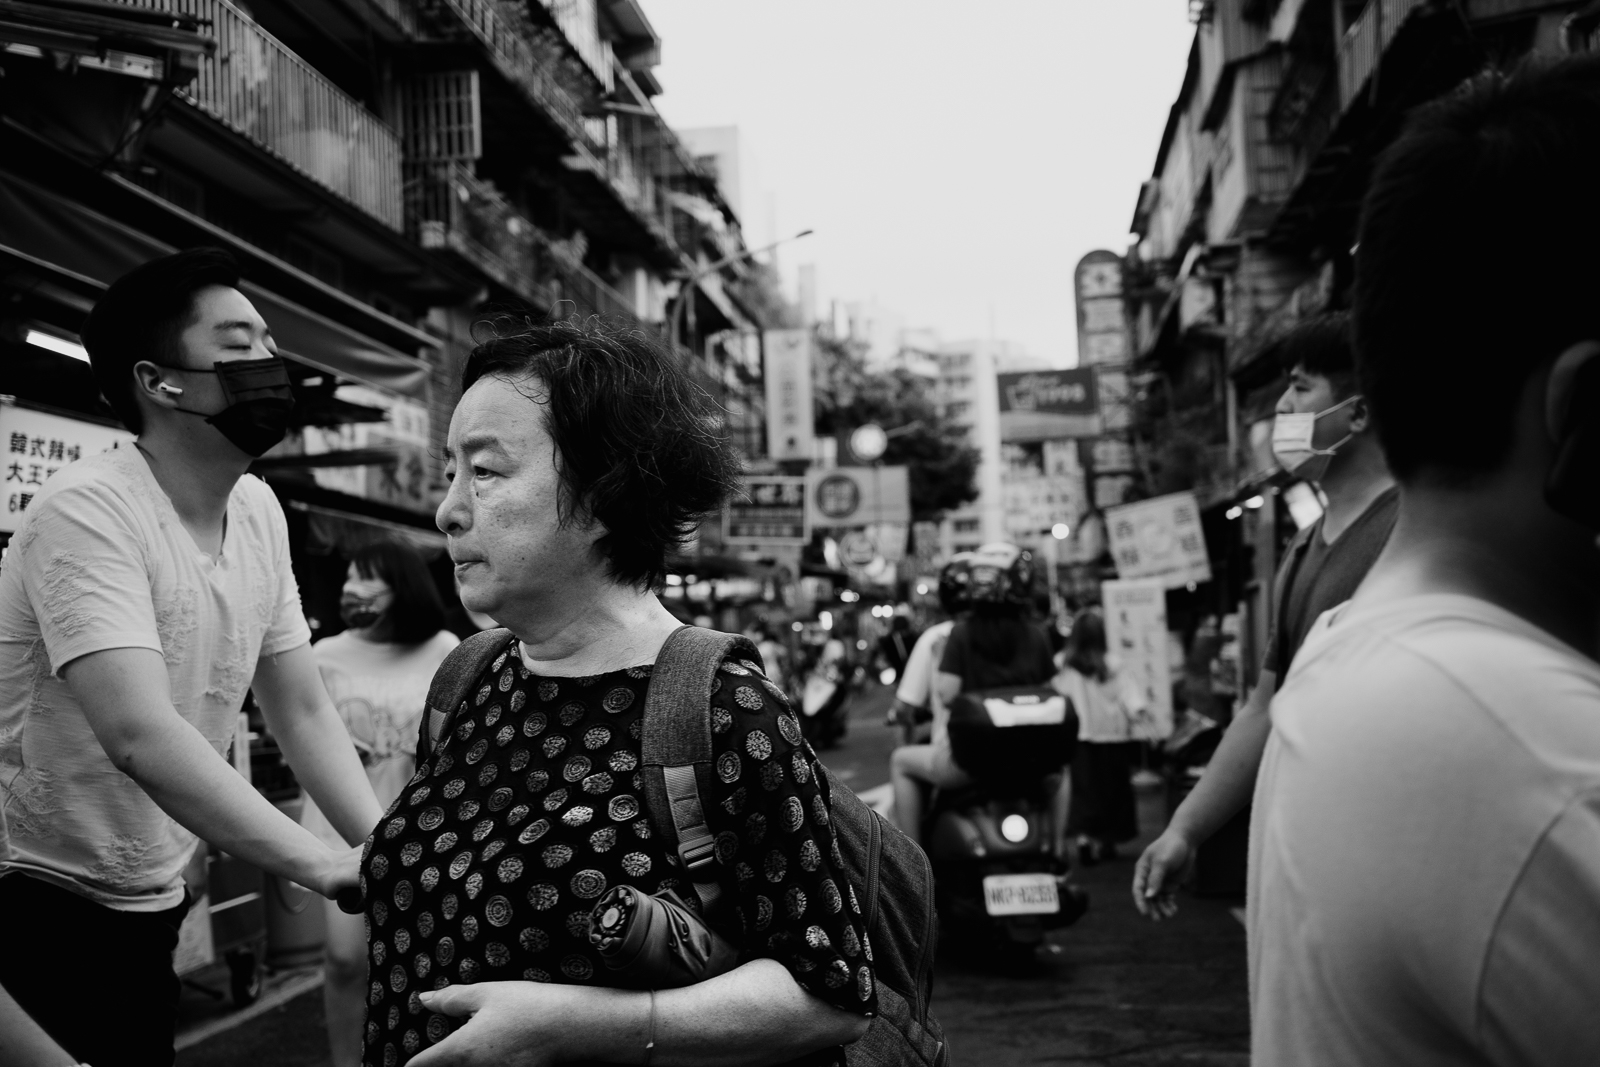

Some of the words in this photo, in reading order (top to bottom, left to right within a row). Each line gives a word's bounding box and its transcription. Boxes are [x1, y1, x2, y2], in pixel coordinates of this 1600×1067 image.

[9, 431, 82, 461] 韓式辣味
[6, 462, 60, 486] 大王
